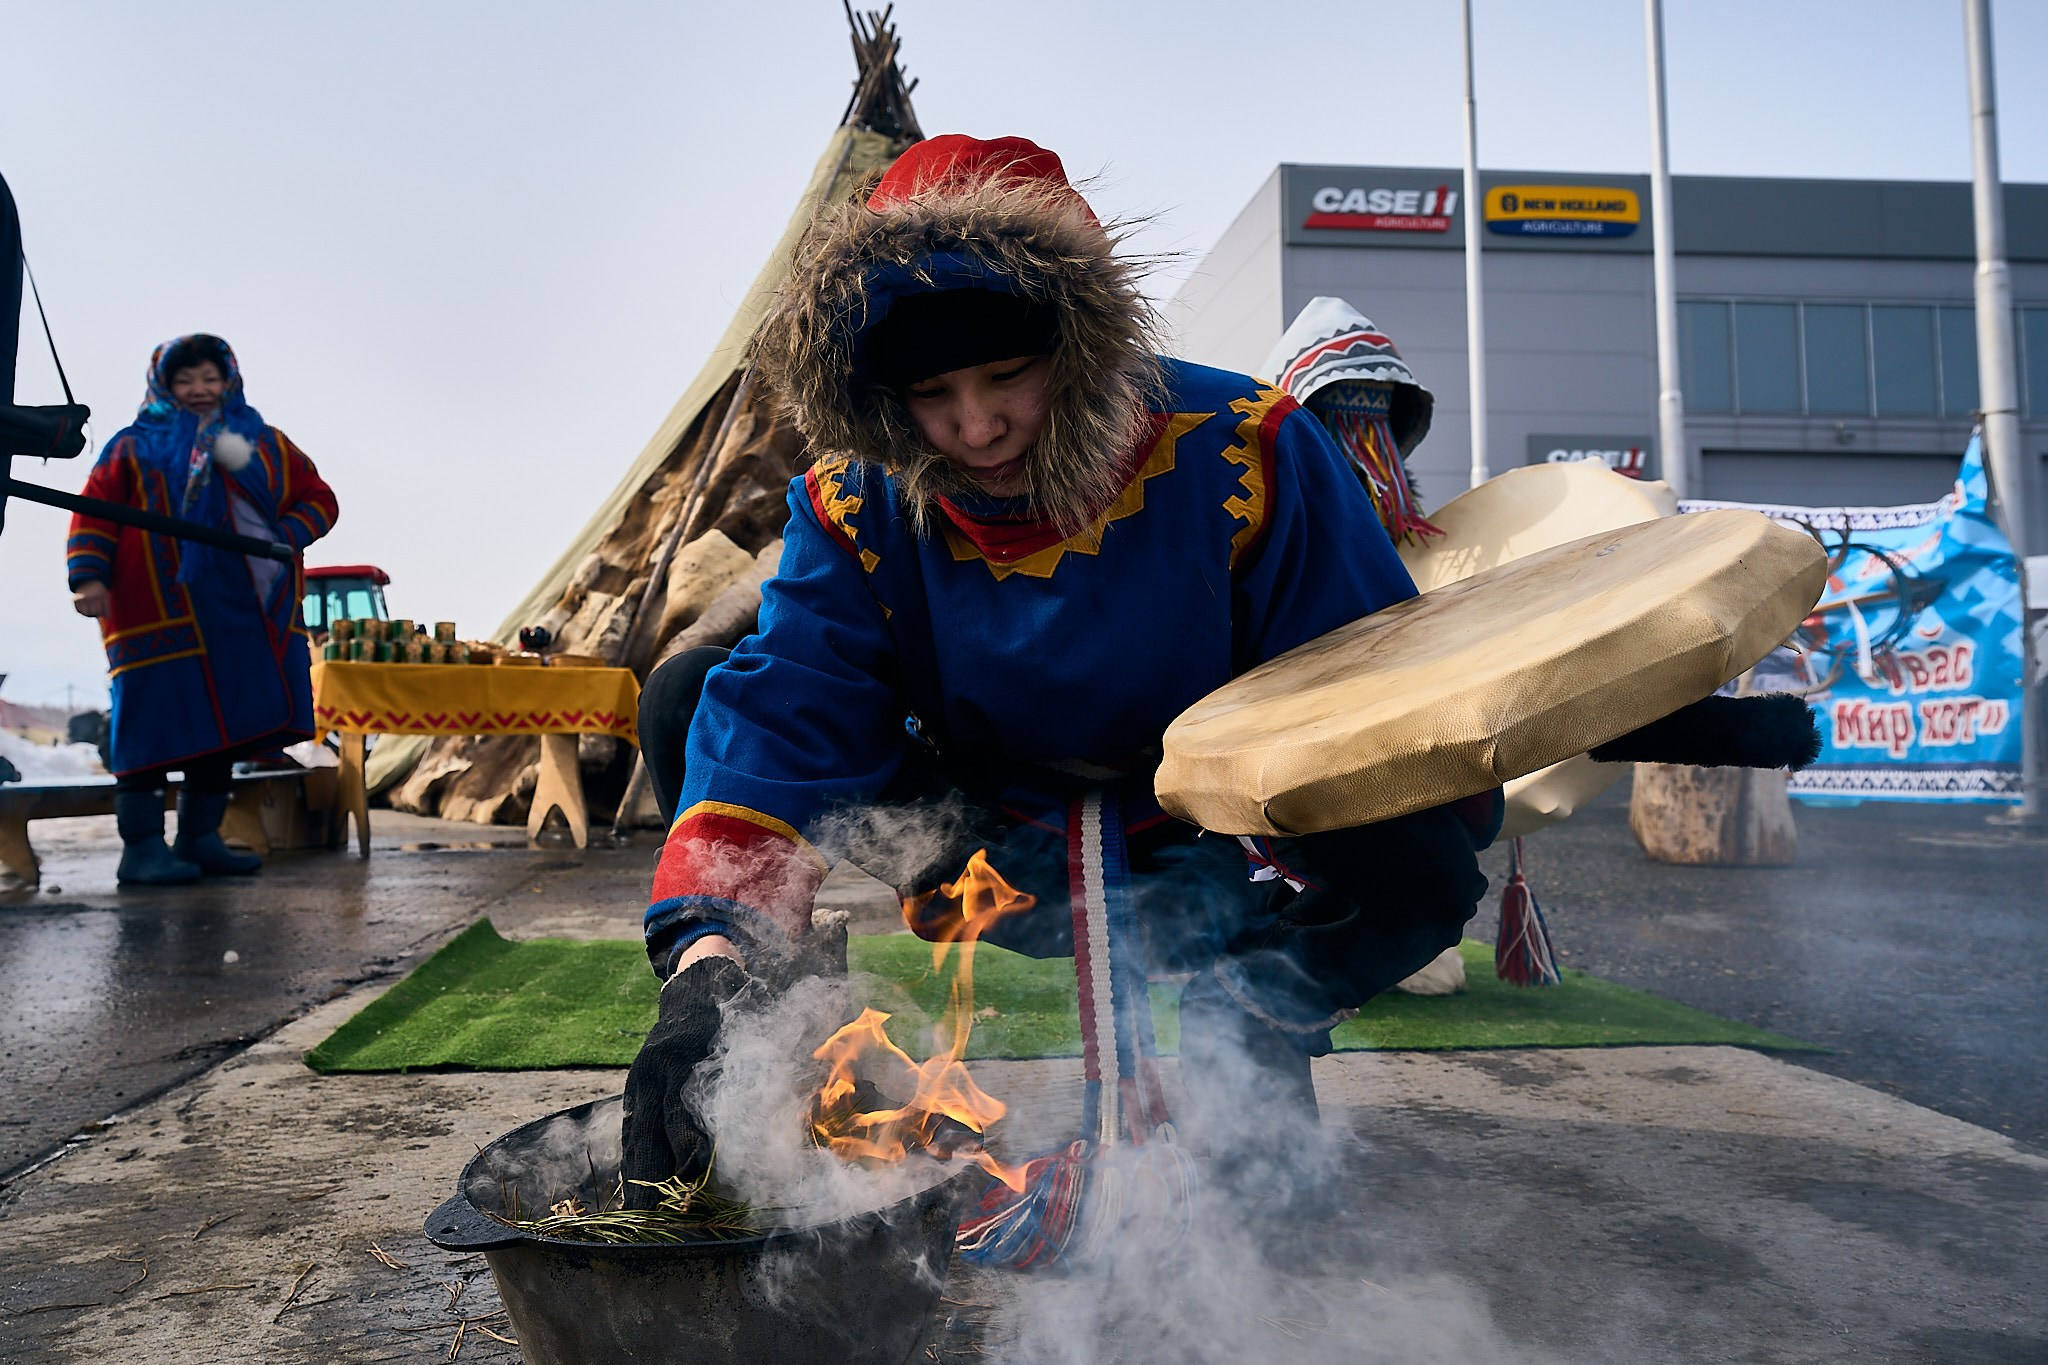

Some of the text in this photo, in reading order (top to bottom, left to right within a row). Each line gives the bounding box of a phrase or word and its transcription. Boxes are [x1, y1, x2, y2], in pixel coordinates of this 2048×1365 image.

[1312, 186, 1421, 214] CASE
[1523, 198, 1627, 213] NEW HOLLAND
[1521, 220, 1605, 234] AGRICULTURE
[1836, 702, 1909, 751] Мир
